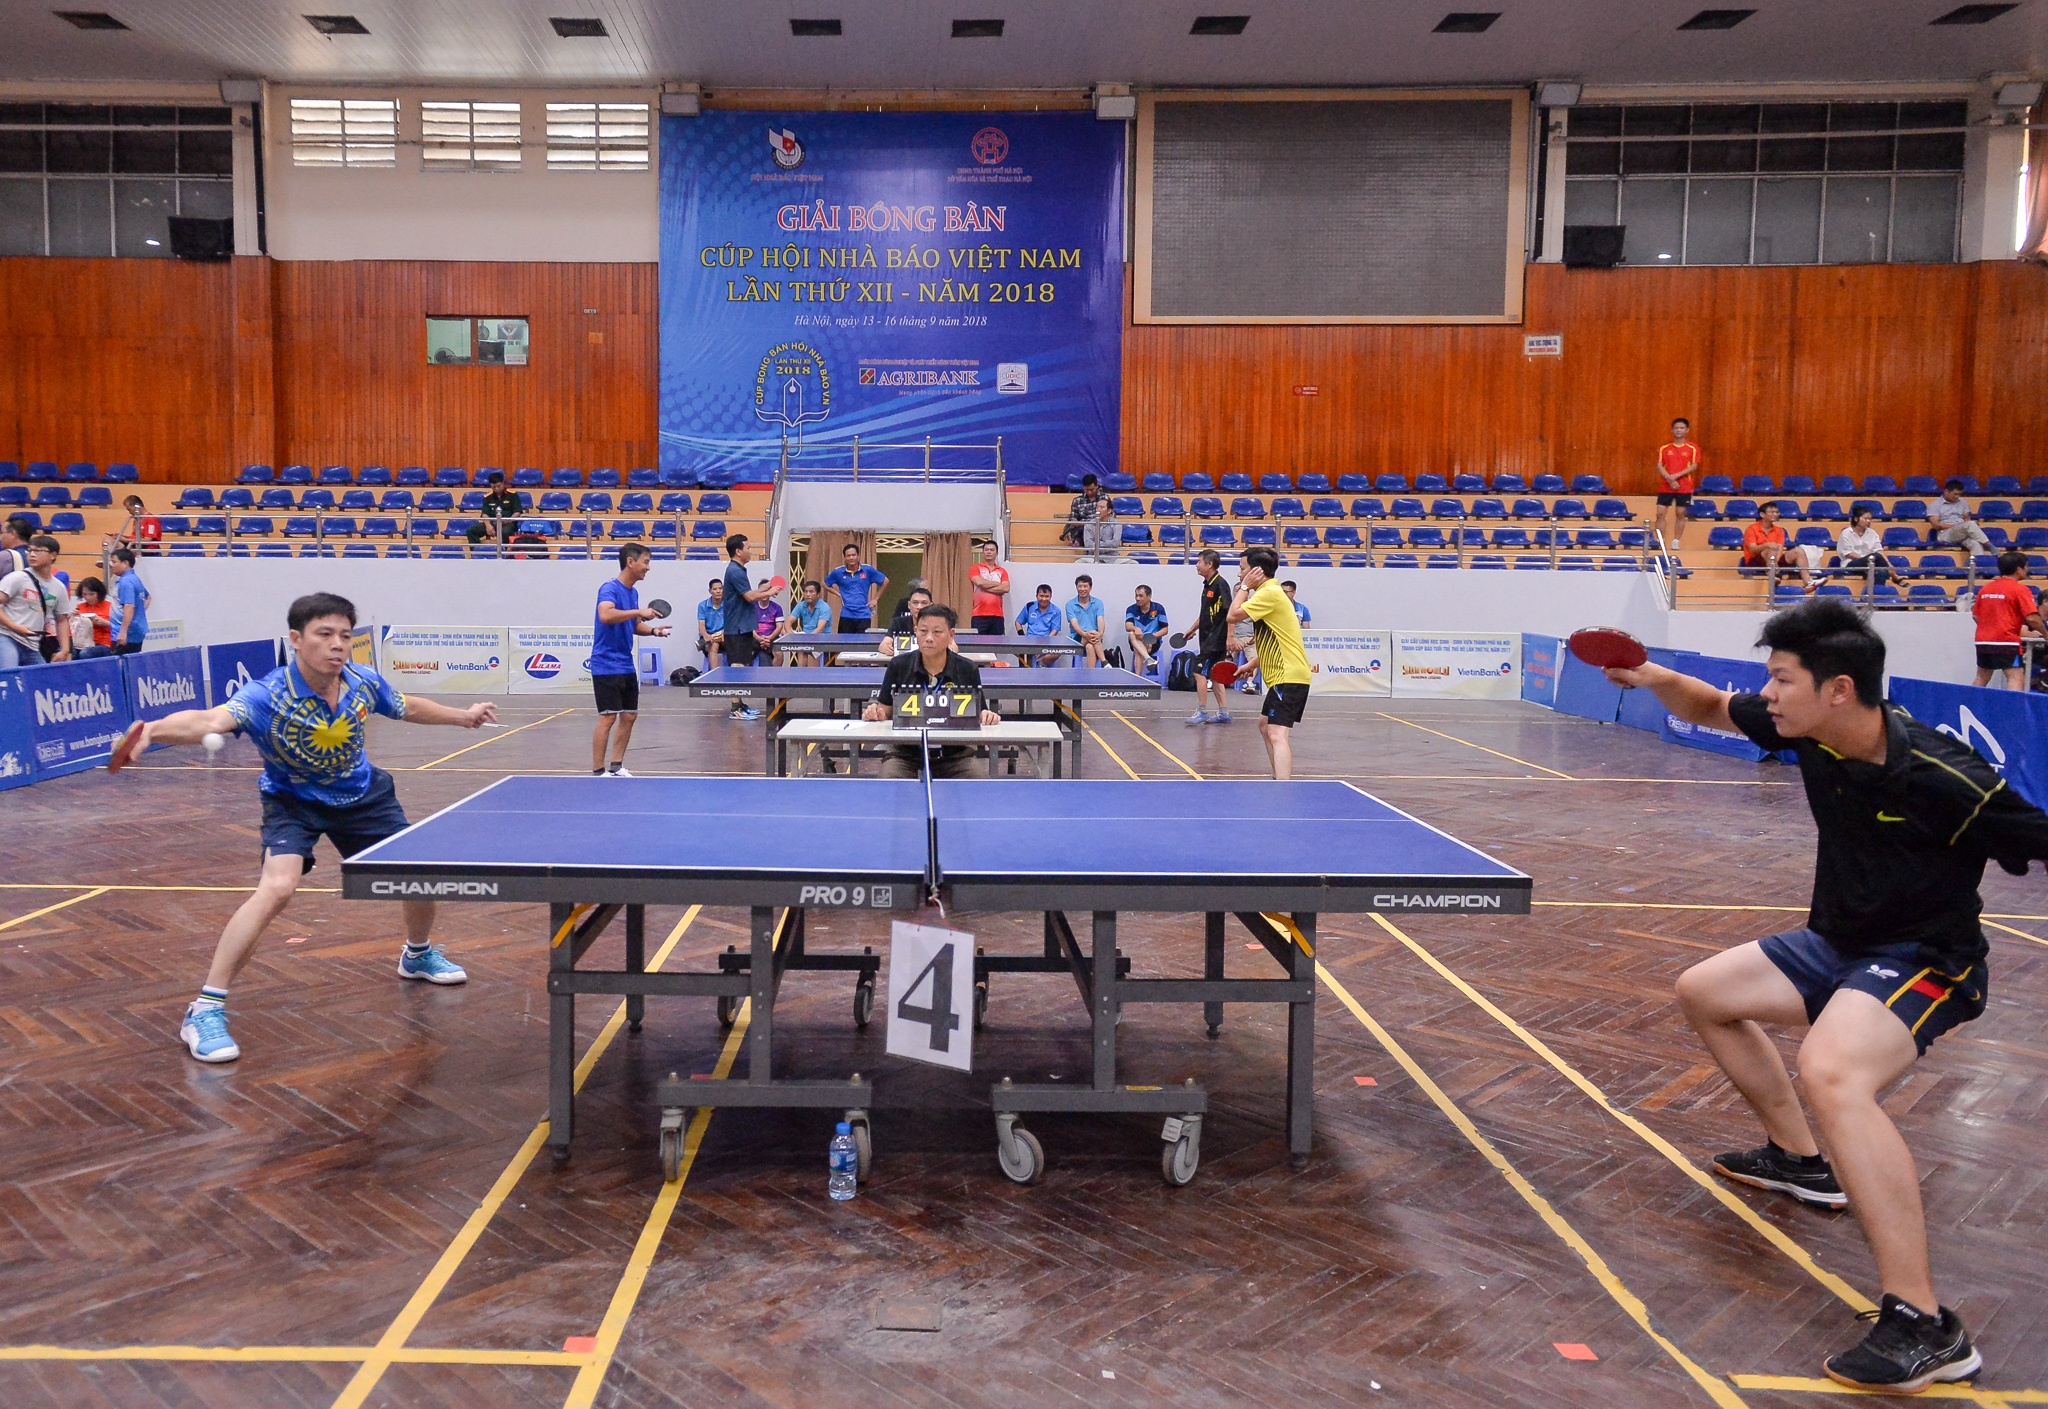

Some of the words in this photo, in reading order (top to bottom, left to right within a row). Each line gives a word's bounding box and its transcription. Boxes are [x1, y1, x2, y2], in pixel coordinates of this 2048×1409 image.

[777, 200, 840, 231] GIẢI
[848, 201, 936, 231] BÓNG
[944, 200, 1006, 231] BÀN
[700, 242, 754, 268] CÚP
[761, 242, 810, 272] HỘI
[819, 243, 877, 268] NHÀ
[886, 244, 940, 269] BÁO
[949, 244, 1011, 273] VIỆT
[1019, 248, 1081, 269] NAM
[727, 275, 781, 302] LẦN
[789, 278, 850, 302] THỨ
[856, 282, 893, 302] XII
[918, 278, 980, 303] NĂM
[989, 282, 1055, 303] 2018
[794, 315, 809, 326] Hà
[812, 315, 832, 327] Nội,
[836, 316, 859, 328] ngày
[863, 315, 874, 326] 13
[884, 315, 897, 326] 16
[899, 316, 926, 327] tháng
[930, 316, 937, 326] 9
[938, 316, 960, 326] năm
[962, 316, 988, 326] 2018
[769, 342, 789, 357] BÀN
[791, 341, 808, 353] HỘI
[809, 348, 827, 367] NHÀ
[757, 356, 771, 384] BÓNG
[776, 366, 811, 375] 2018
[877, 370, 980, 386] AGRIBANK
[820, 369, 830, 389] BÁO
[755, 385, 764, 405] CÚP
[822, 390, 830, 406] V.N
[898, 637, 909, 650] 7
[447, 662, 490, 671] VietinBank
[530, 653, 561, 669] LILAMA
[1327, 665, 1371, 674] VietinBank
[1457, 668, 1501, 677] VietinBank
[137, 672, 196, 709] Nittaku
[701, 688, 751, 696] CHAMPION
[34, 683, 114, 726] Nittaku
[901, 694, 921, 717] 4
[925, 695, 935, 707] 0
[938, 695, 948, 707] 0
[953, 694, 972, 716] 7
[371, 881, 498, 896] CHAMPION
[799, 886, 847, 905] PRO
[852, 886, 865, 906] 9
[1373, 895, 1500, 908] CHAMPION
[897, 943, 959, 1054] 4
